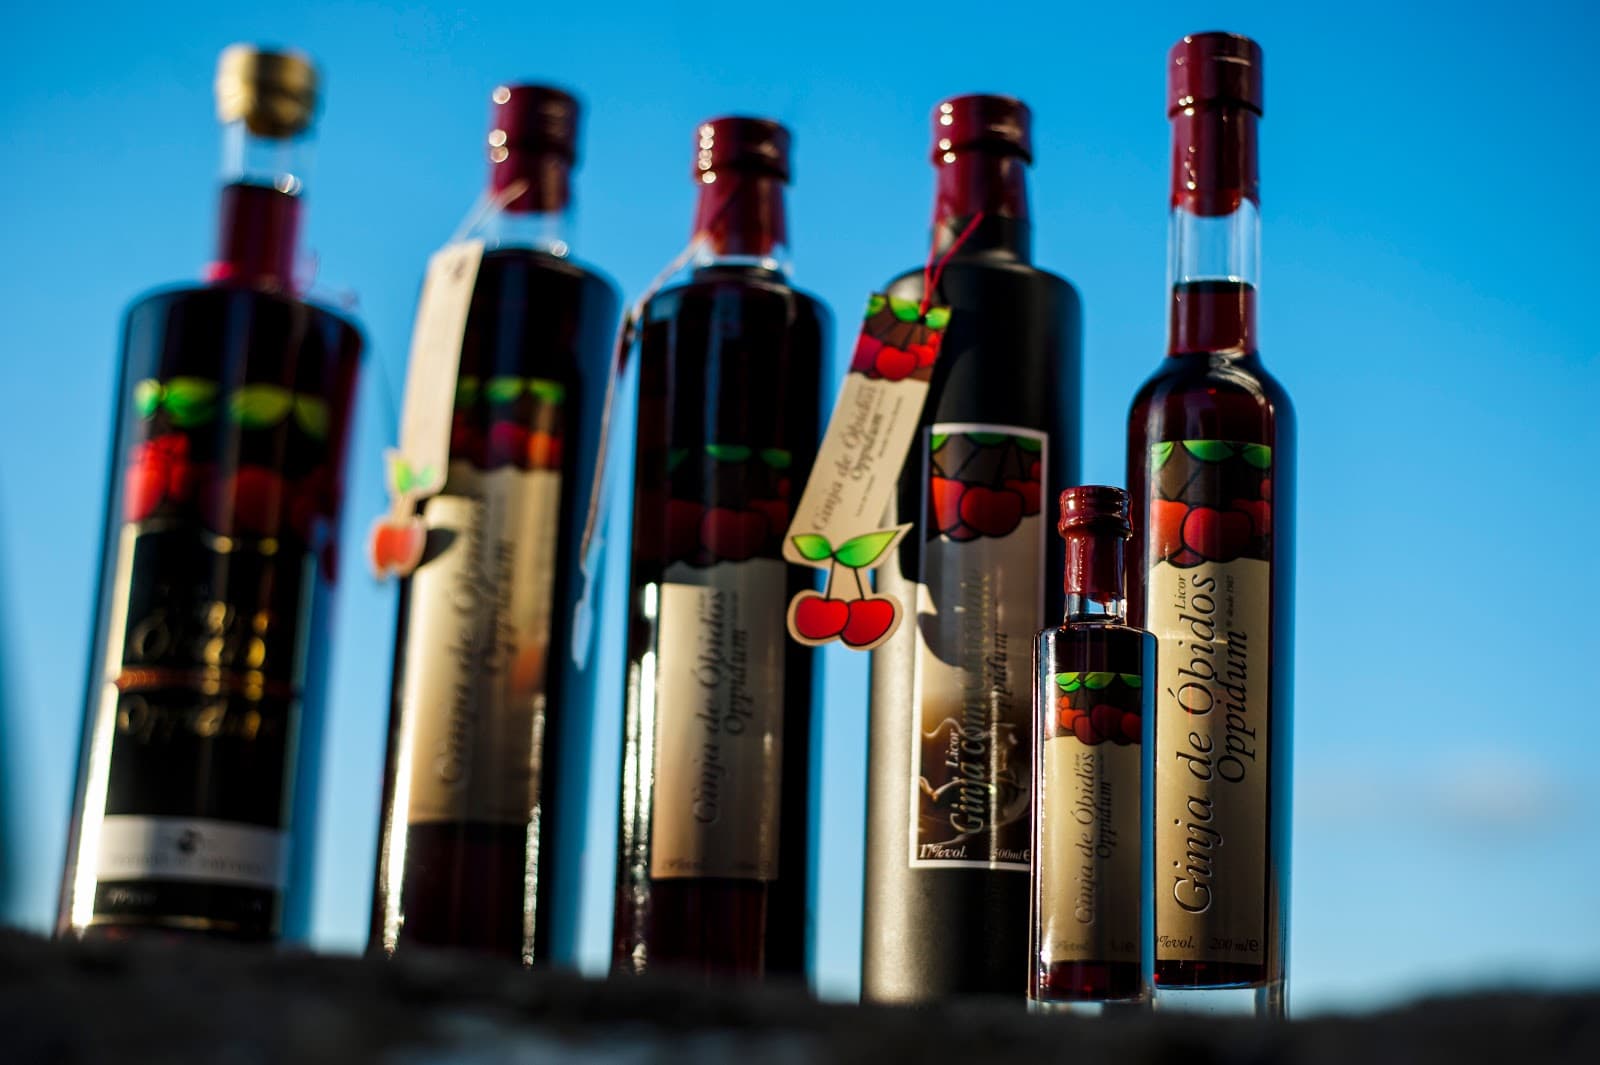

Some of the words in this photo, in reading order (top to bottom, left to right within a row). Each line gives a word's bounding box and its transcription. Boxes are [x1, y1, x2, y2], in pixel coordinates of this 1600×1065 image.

[1174, 575, 1186, 609] Licor
[1168, 574, 1217, 715] Óbidos
[1216, 631, 1256, 783] Oppidum
[946, 729, 959, 767] Licor
[1177, 731, 1214, 782] de
[950, 761, 987, 834] Ginja
[1071, 753, 1096, 826] Óbidos
[1095, 781, 1116, 859] Oppidum
[1074, 833, 1094, 858] de
[1174, 796, 1223, 914] Ginja
[1074, 864, 1097, 925] Ginja
